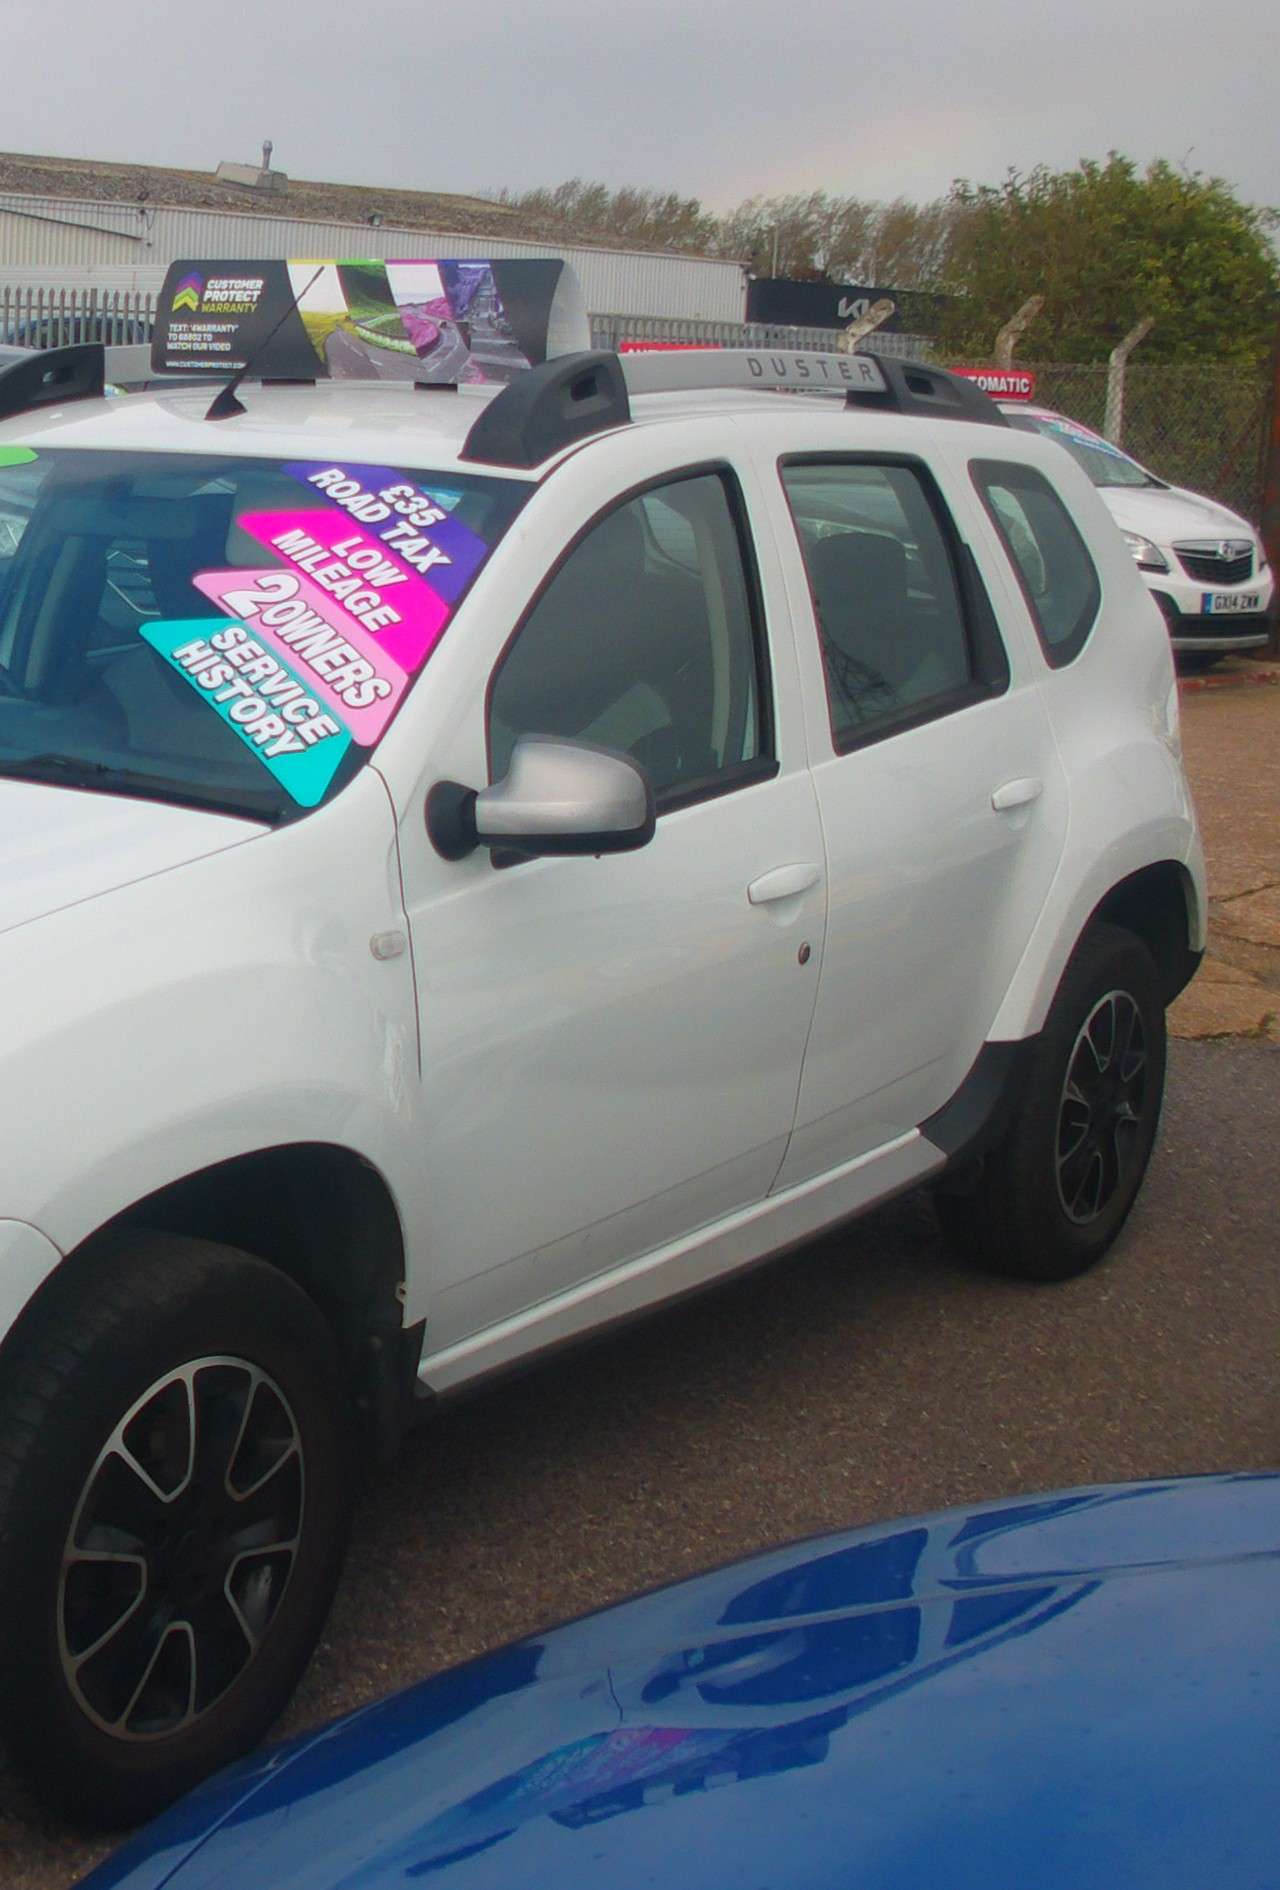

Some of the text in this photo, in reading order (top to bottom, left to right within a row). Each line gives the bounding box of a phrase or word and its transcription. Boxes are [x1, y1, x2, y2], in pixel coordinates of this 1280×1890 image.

[203, 290, 261, 302] PROTECT
[206, 279, 264, 289] CUSTOMER
[201, 303, 257, 313] WARRANTY
[208, 342, 231, 351] VIDEO
[746, 357, 875, 381] DUSTER
[968, 376, 1030, 393] OMATIC
[307, 468, 452, 574] ROAD TAX
[377, 484, 447, 528] £35
[271, 528, 403, 633] MILEAGE
[330, 536, 408, 589] LOW
[220, 573, 393, 709] 2 OWNERS
[172, 639, 307, 759] HISTORY
[210, 627, 340, 746] SERVICE
